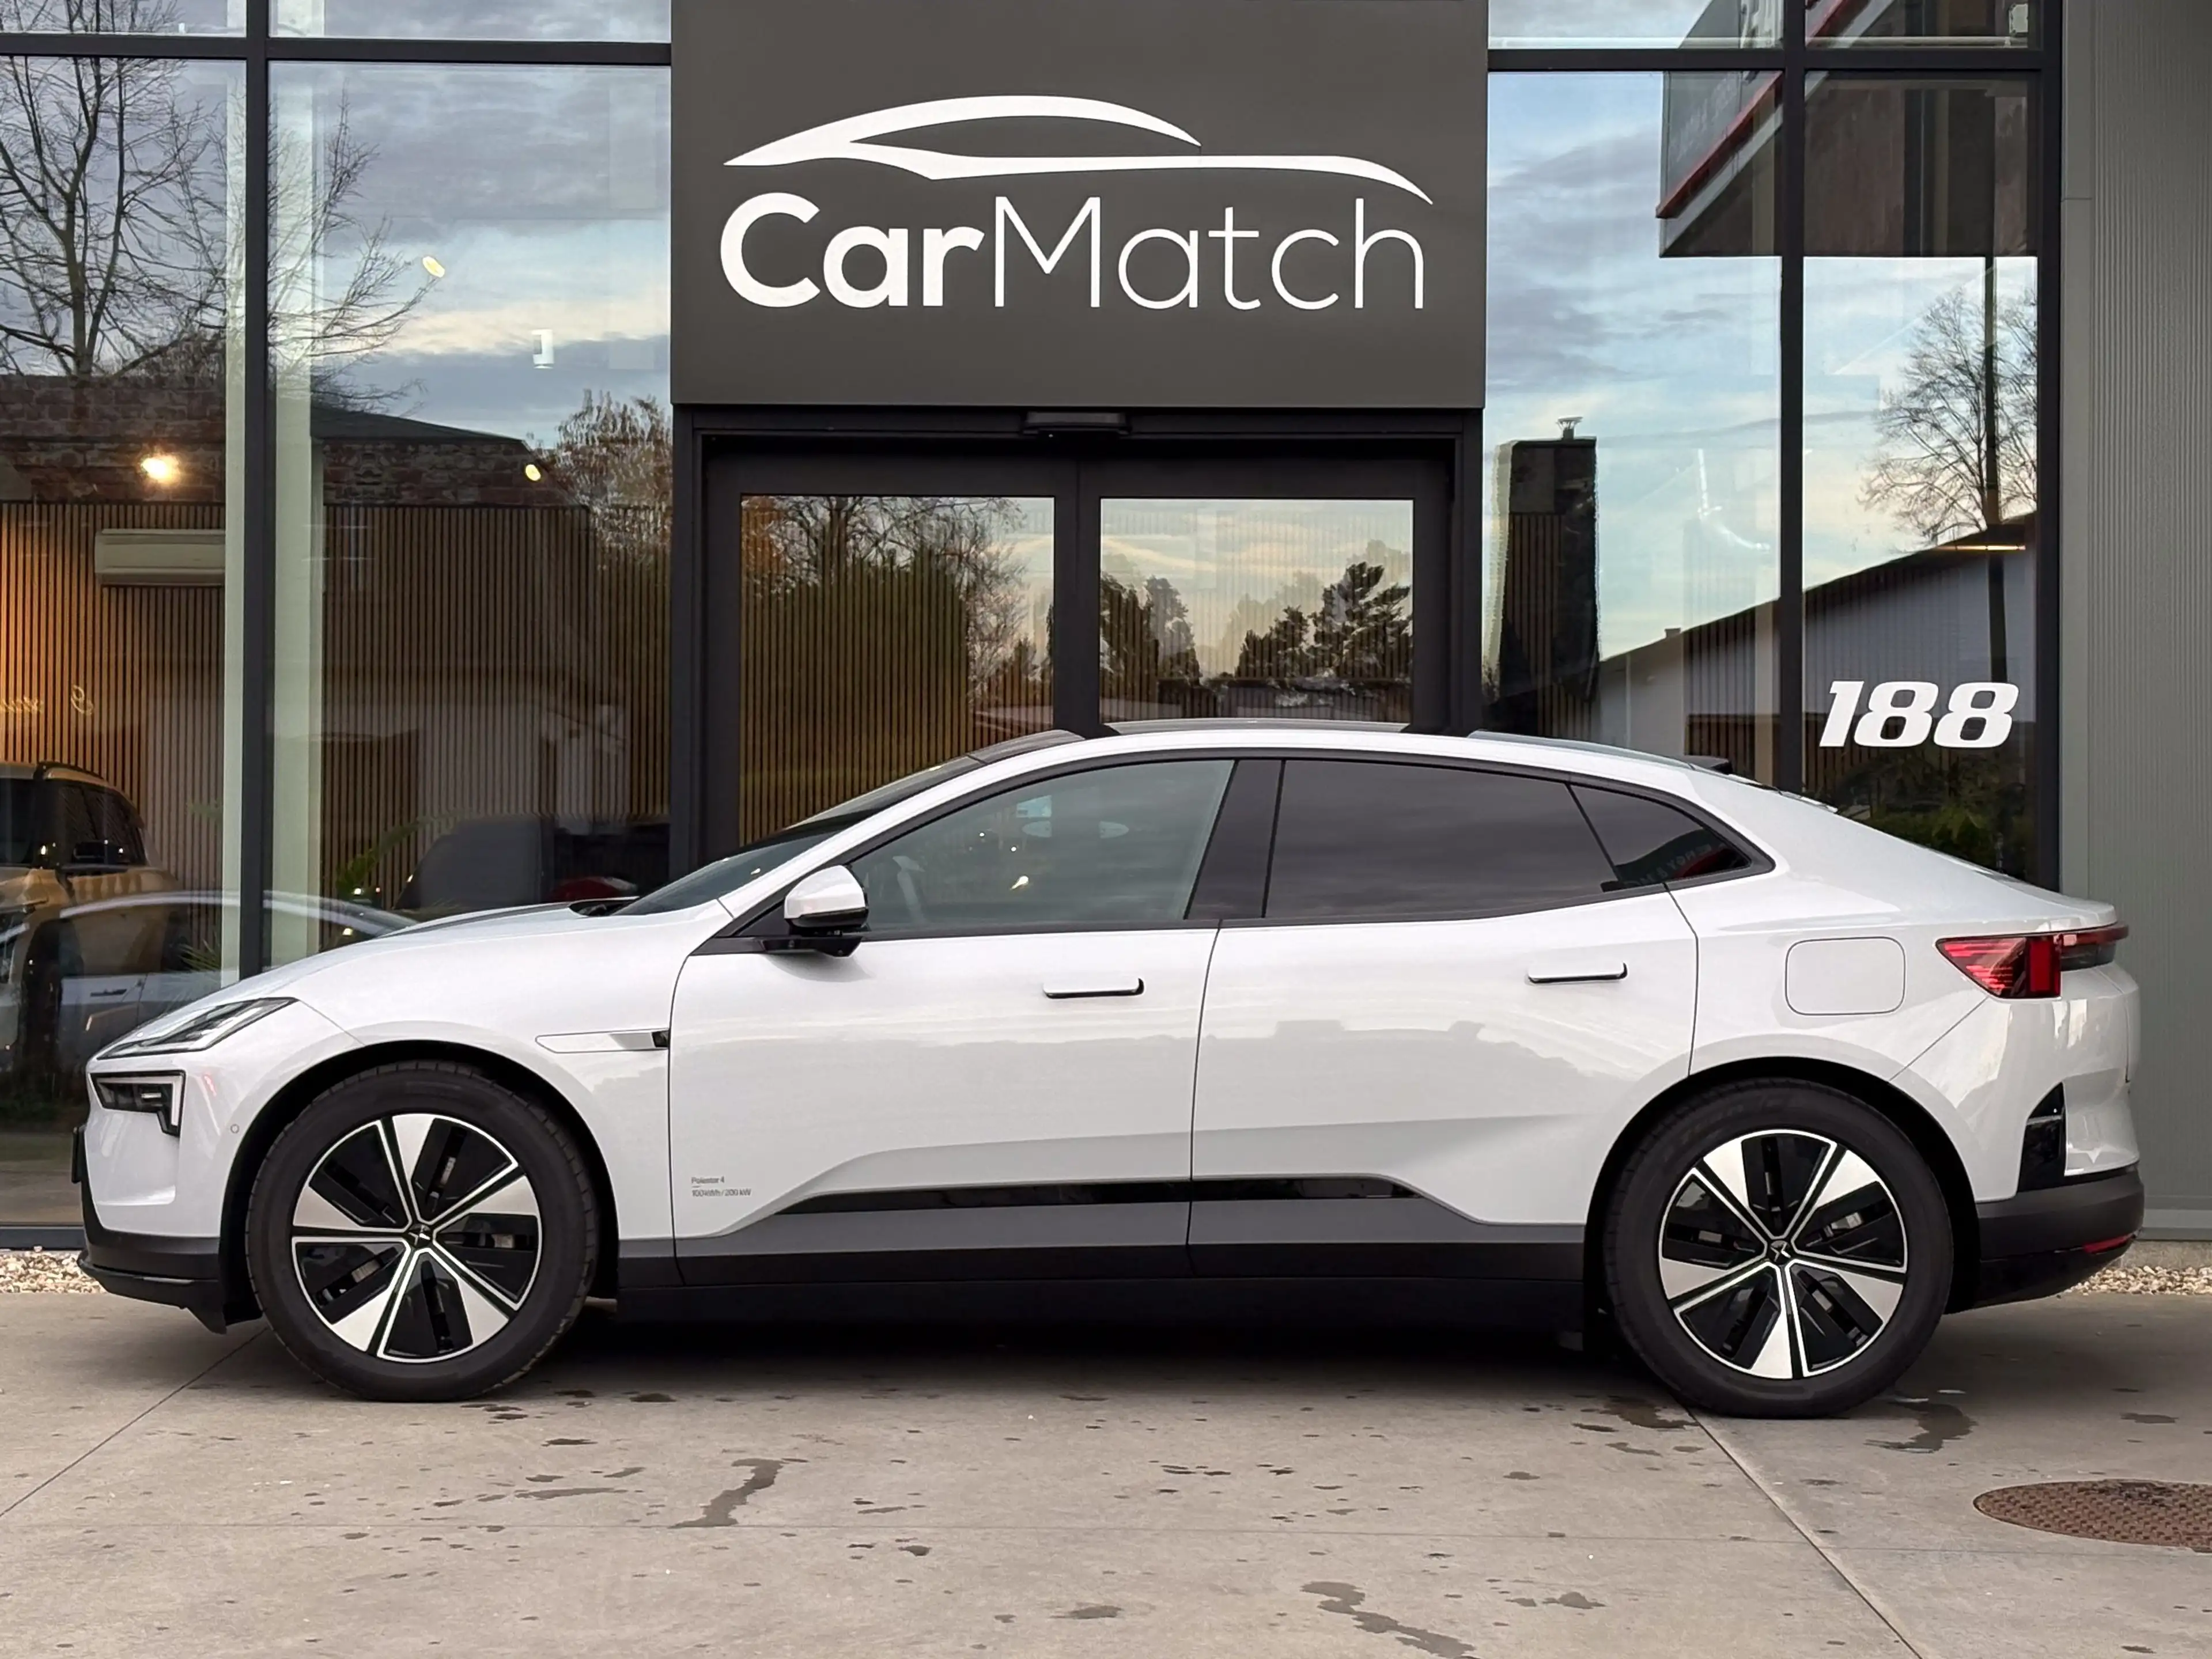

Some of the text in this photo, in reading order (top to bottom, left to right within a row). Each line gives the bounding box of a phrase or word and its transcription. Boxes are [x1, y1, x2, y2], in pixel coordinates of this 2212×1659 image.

[720, 192, 1424, 309] CarMatch
[1820, 681, 2019, 748] 188
[739, 1188, 751, 1196] kW
